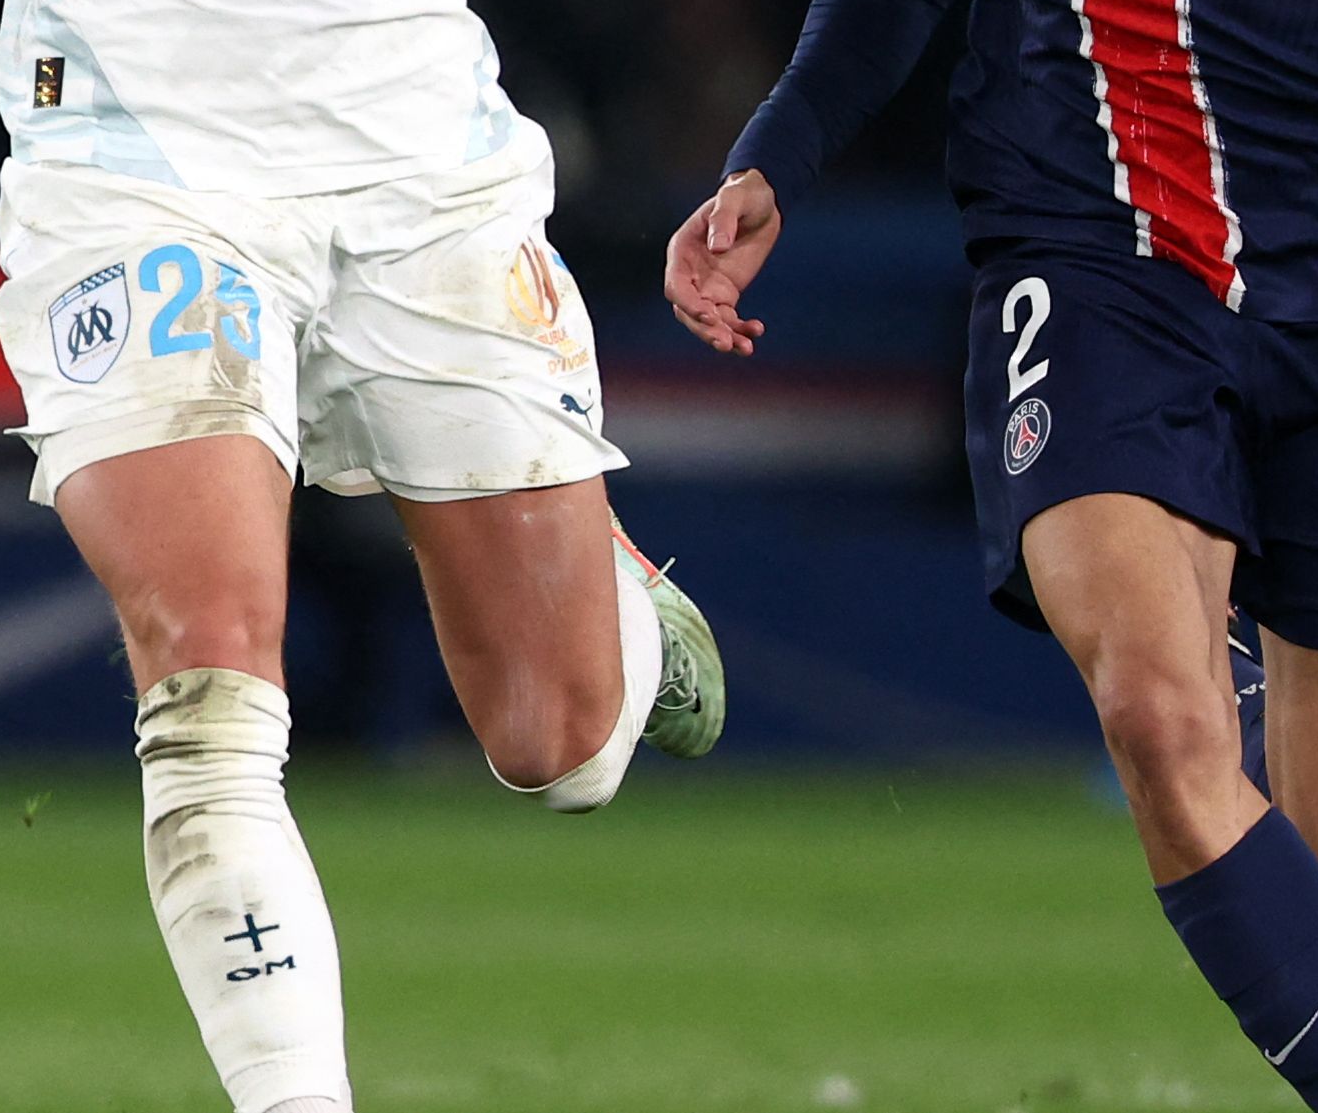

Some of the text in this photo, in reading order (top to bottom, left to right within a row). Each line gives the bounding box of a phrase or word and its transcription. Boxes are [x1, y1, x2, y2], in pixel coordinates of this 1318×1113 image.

[1002, 277, 1051, 402] 2
[1008, 402, 1039, 433] PARIS
[226, 955, 296, 981] OM
